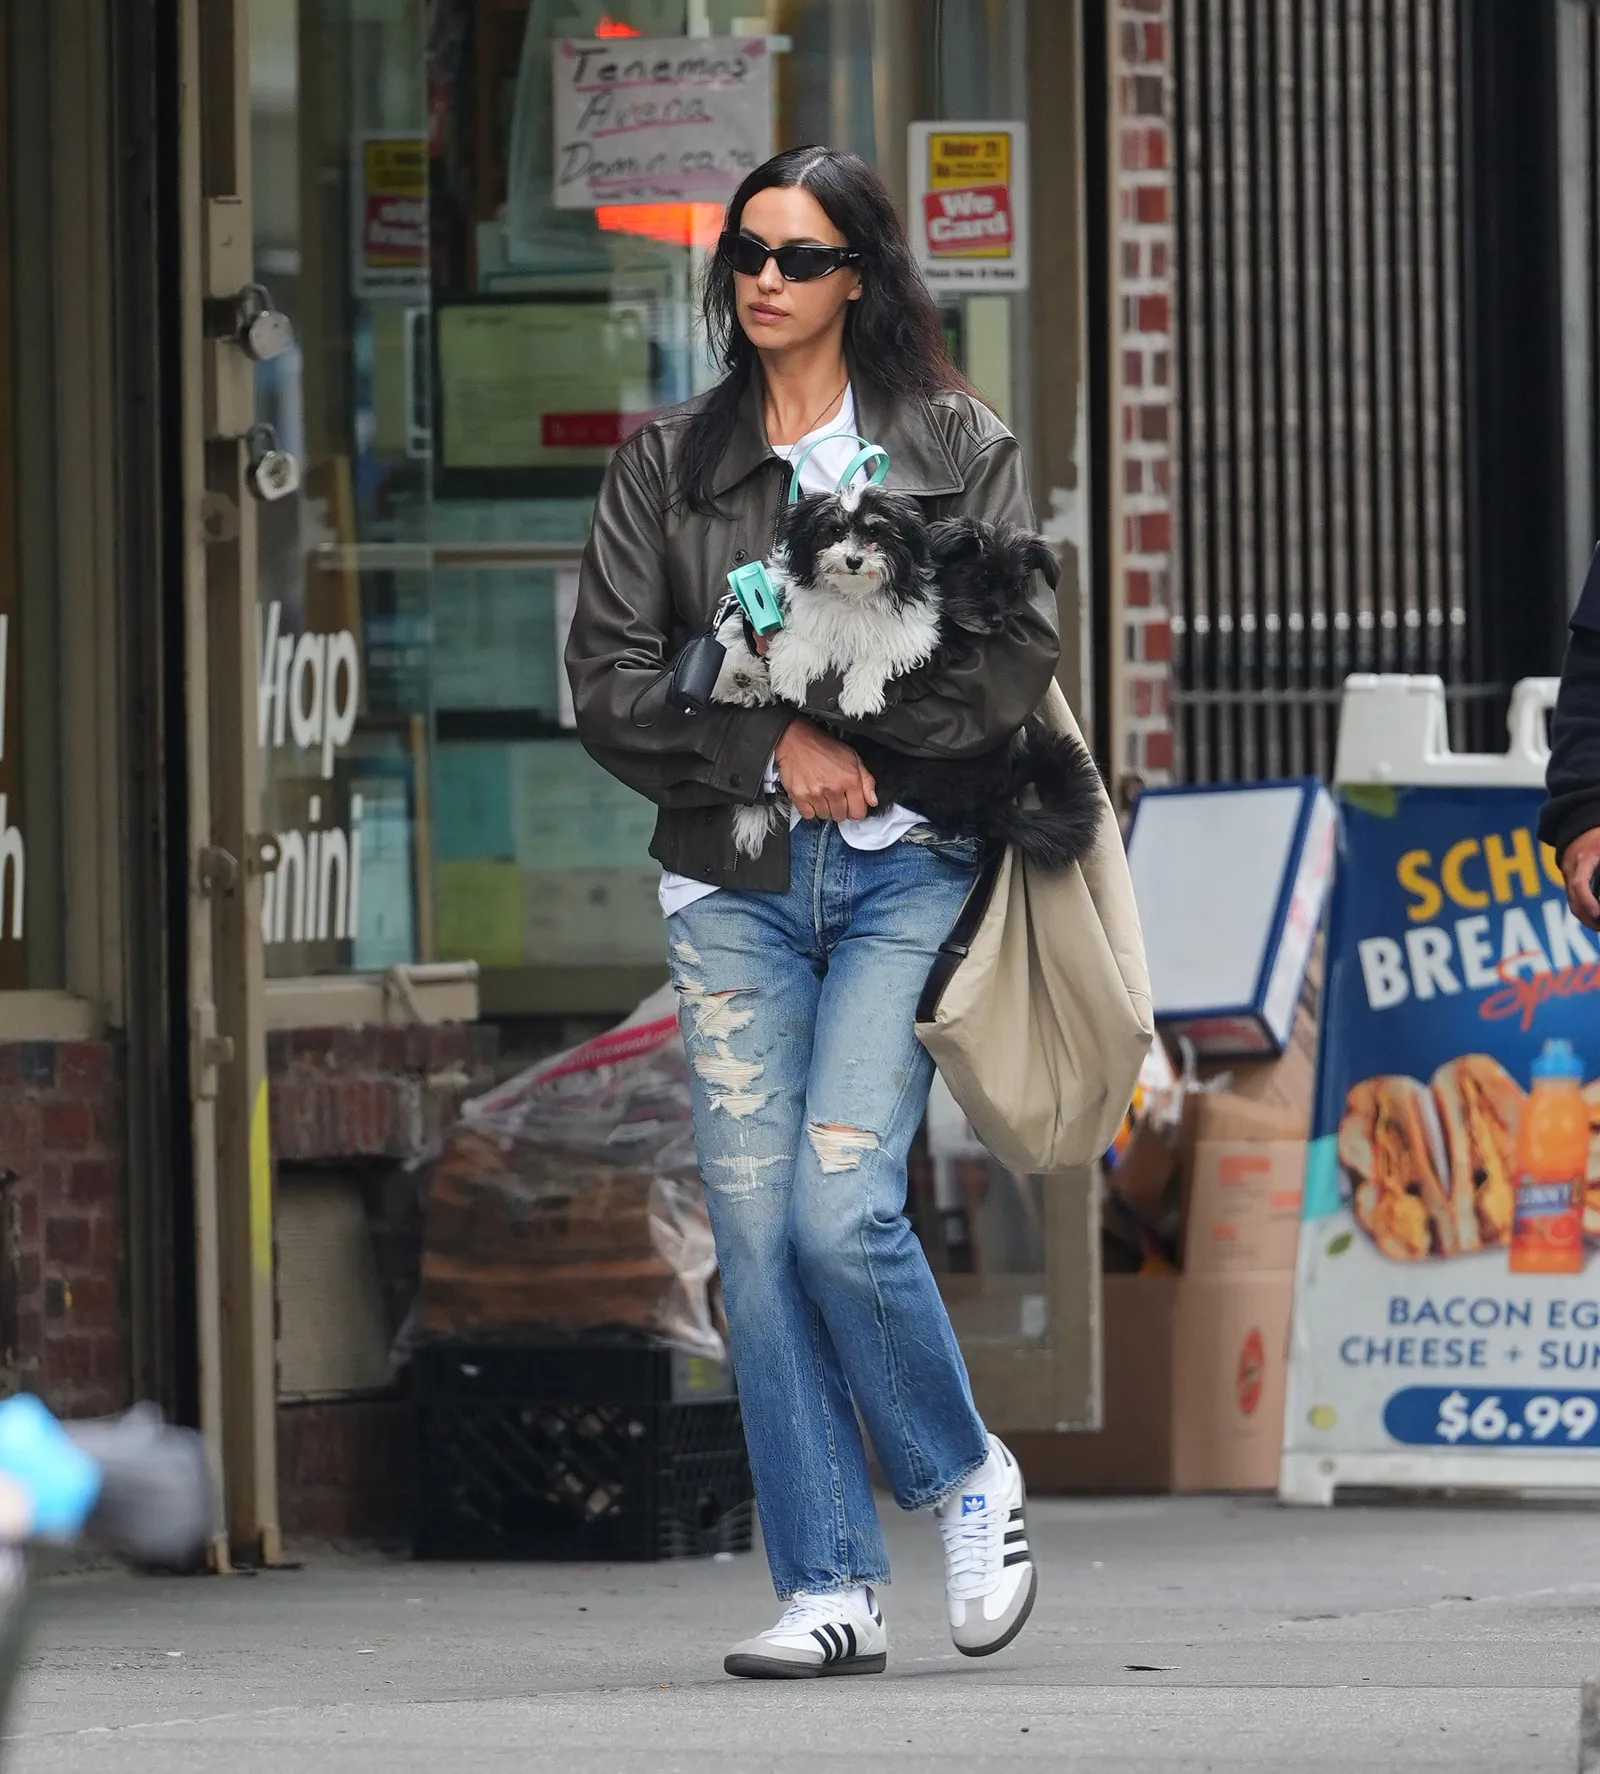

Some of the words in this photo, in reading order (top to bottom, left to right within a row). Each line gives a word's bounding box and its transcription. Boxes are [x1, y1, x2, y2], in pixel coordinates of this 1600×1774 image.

[939, 191, 995, 217] We
[930, 211, 1009, 242] Card
[1388, 1297, 1532, 1328] BACON
[1547, 1300, 1599, 1330] EG
[1339, 1336, 1488, 1368] CHEESE
[1435, 1389, 1599, 1442] $6.99
